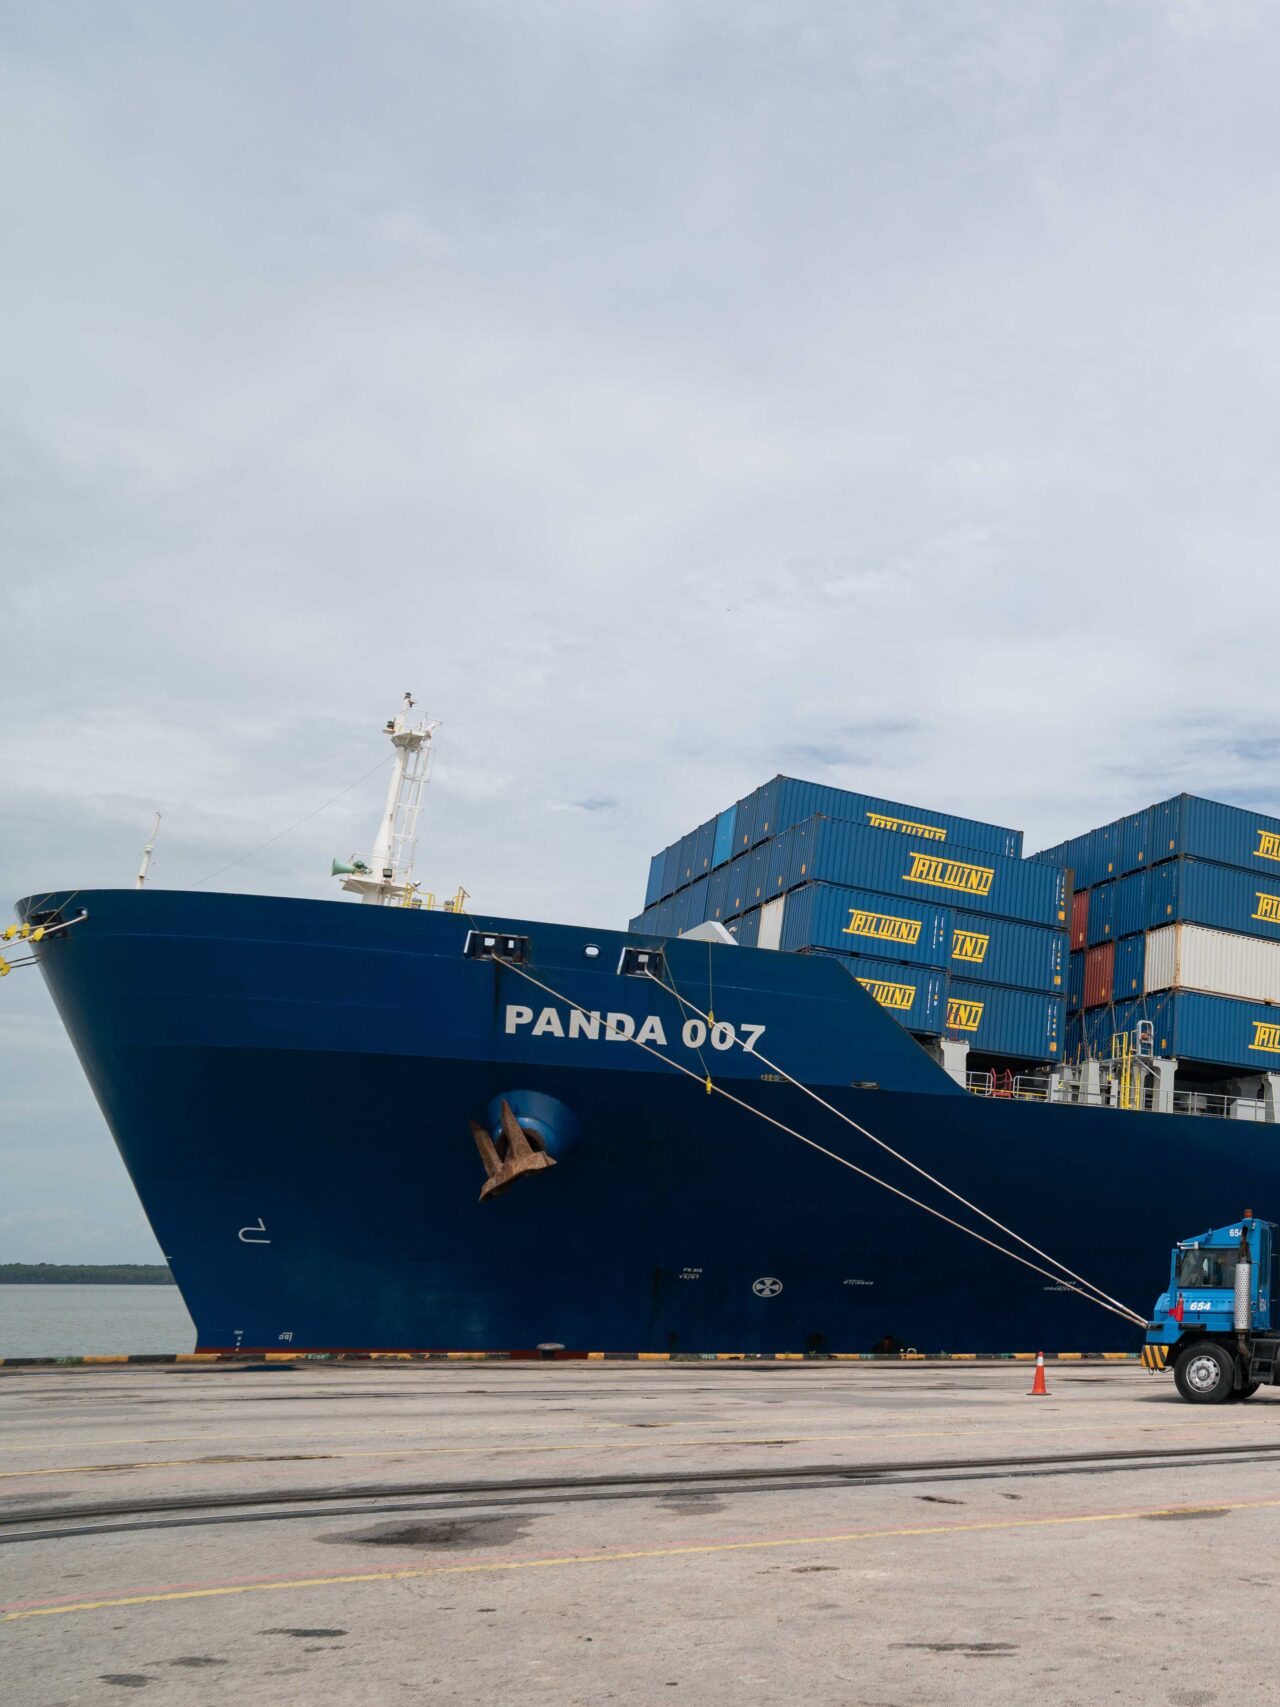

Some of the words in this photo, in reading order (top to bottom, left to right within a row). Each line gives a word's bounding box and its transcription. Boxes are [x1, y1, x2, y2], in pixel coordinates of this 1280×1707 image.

[902, 852, 995, 896] TAILWIND
[842, 908, 922, 945] TAILWIND
[505, 1004, 668, 1046] PANDA
[682, 1019, 766, 1052] 007
[1190, 1302, 1212, 1311] 654
